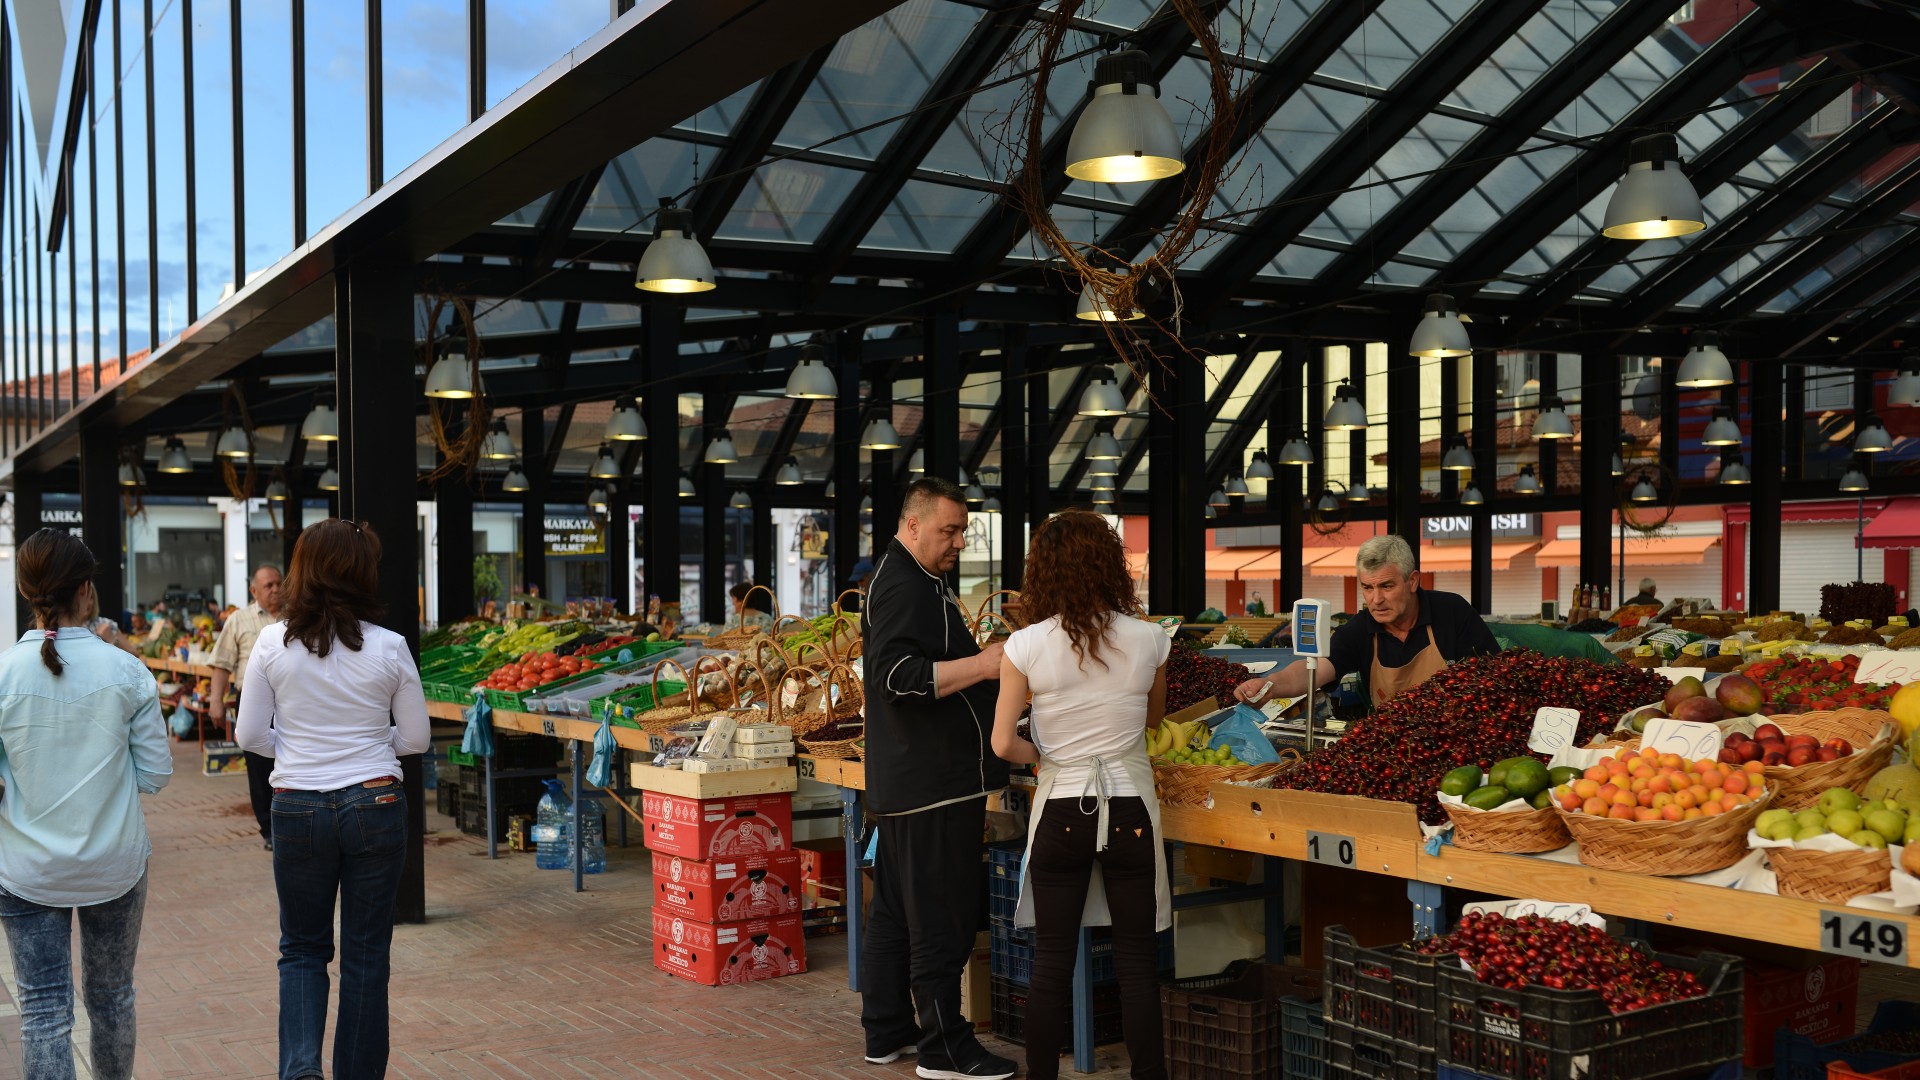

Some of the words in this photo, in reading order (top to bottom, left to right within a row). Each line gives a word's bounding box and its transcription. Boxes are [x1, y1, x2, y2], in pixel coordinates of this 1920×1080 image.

[570, 534, 598, 542] PESHK
[552, 543, 585, 552] BULMET
[543, 721, 555, 734] 154
[650, 738, 664, 751] 153
[1001, 790, 1028, 812] 151
[659, 832, 675, 841] MEXICO
[666, 882, 686, 893] BANANAS
[667, 893, 687, 906] MEXICO
[1825, 916, 1903, 957] 149
[668, 943, 688, 955] BANANAS
[668, 954, 689, 967] MEXICO
[1794, 1001, 1831, 1019] BANANAS
[1794, 1017, 1829, 1035] MEXICO
